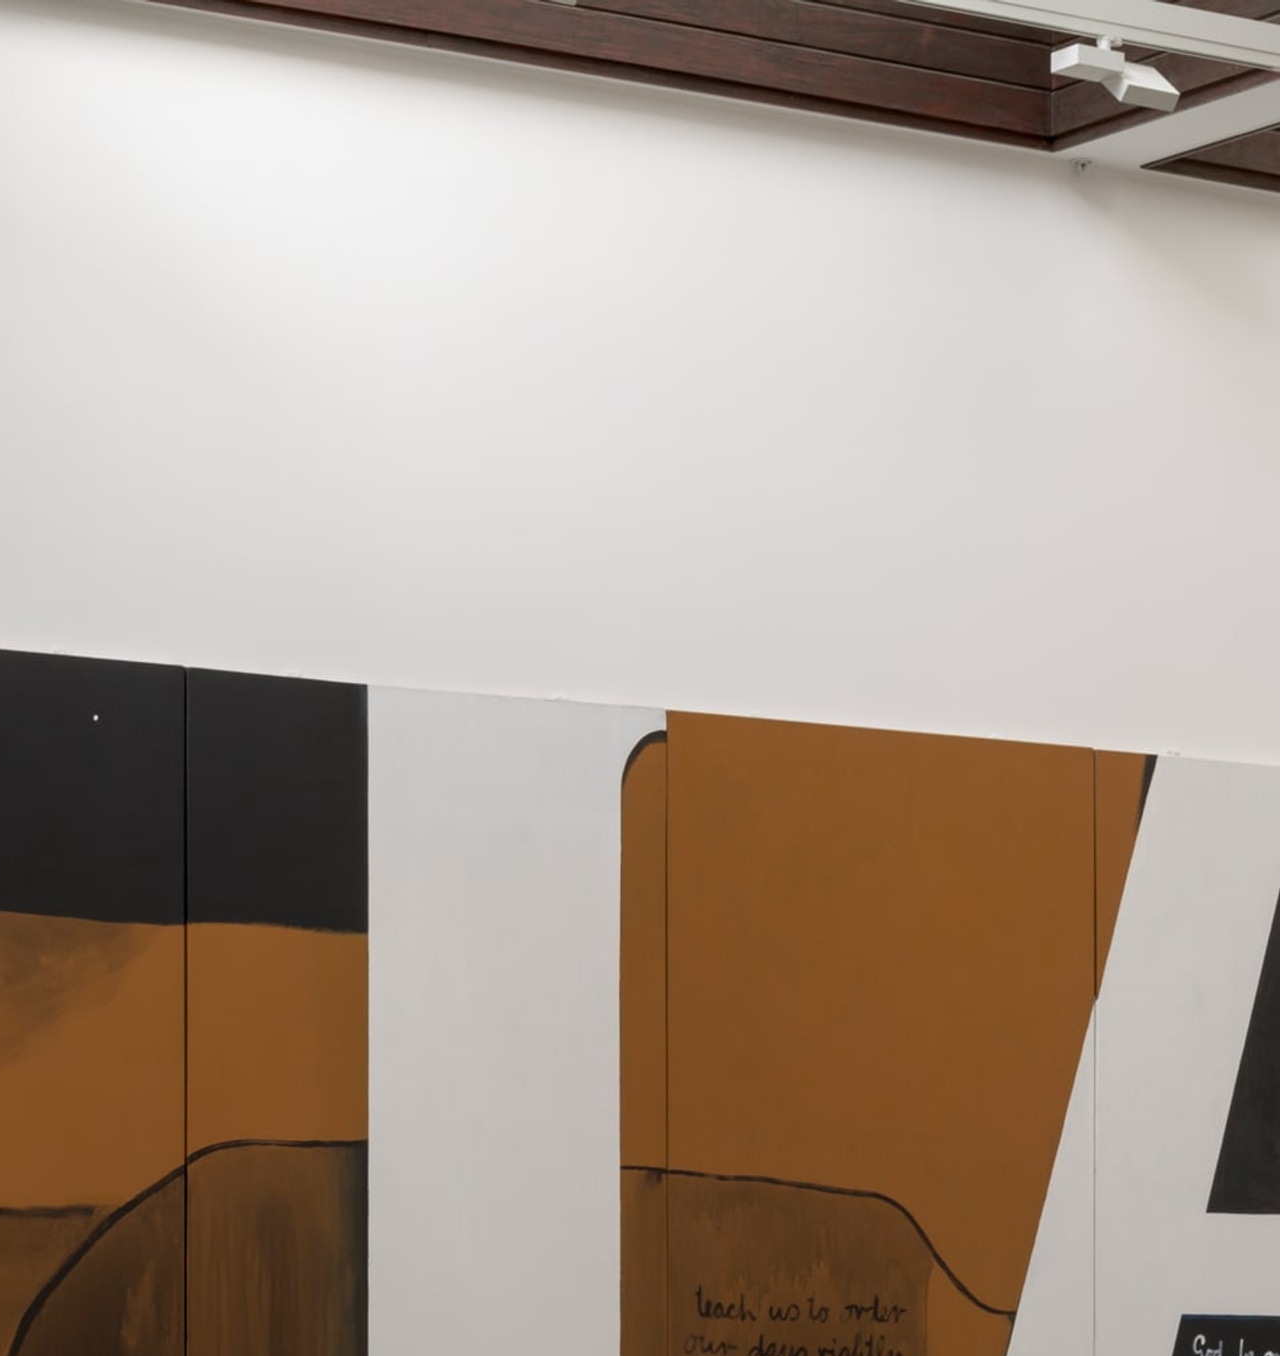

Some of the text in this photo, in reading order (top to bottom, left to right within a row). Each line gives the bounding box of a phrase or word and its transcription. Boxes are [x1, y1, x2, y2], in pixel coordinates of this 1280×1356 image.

[695, 1284, 757, 1322] teach
[768, 1303, 800, 1322] us
[807, 1296, 830, 1323] to
[684, 1335, 737, 1355] our
